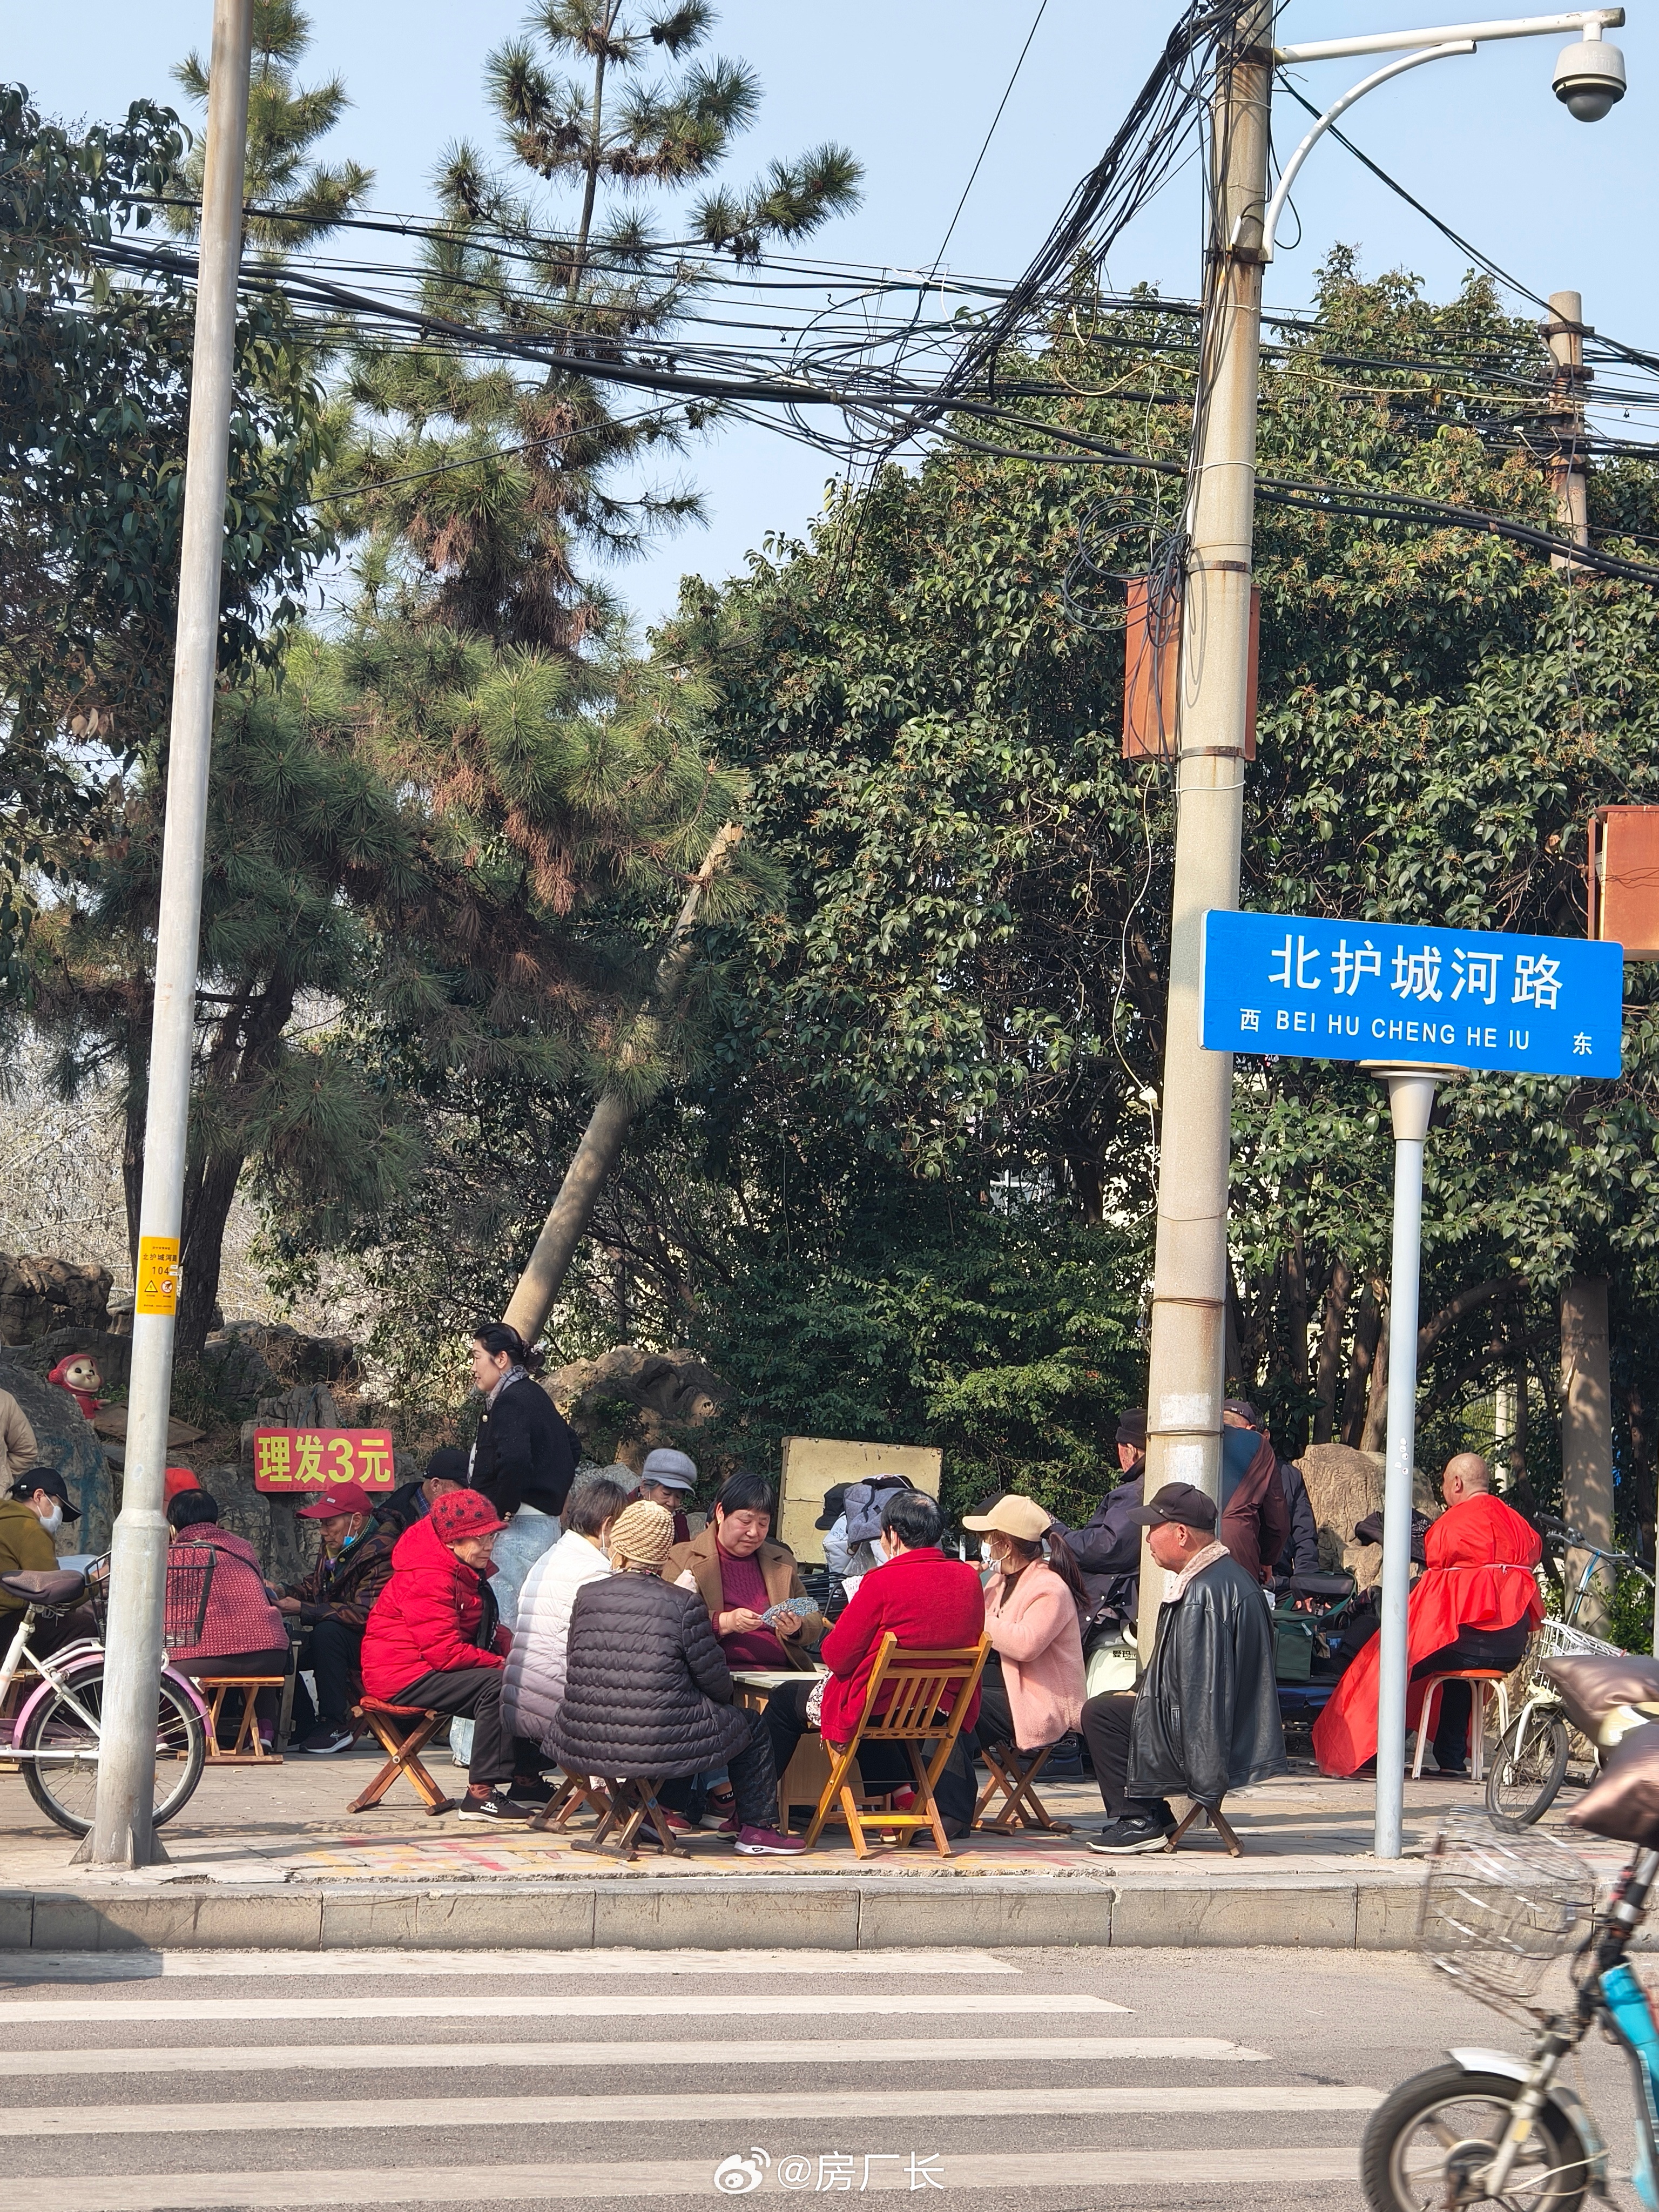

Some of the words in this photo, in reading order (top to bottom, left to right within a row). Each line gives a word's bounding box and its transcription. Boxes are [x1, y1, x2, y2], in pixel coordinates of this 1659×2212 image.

[1268, 934, 1563, 1010] 北护城河路
[1240, 1008, 1261, 1032] 西
[1277, 1010, 1314, 1033] BEI
[1328, 1014, 1359, 1036] HU
[1372, 1018, 1455, 1044] CHENG
[1467, 1027, 1497, 1048] HE
[1573, 1031, 1593, 1055] 东
[152, 1266, 169, 1275] 104
[258, 1435, 391, 1483] 理发3元
